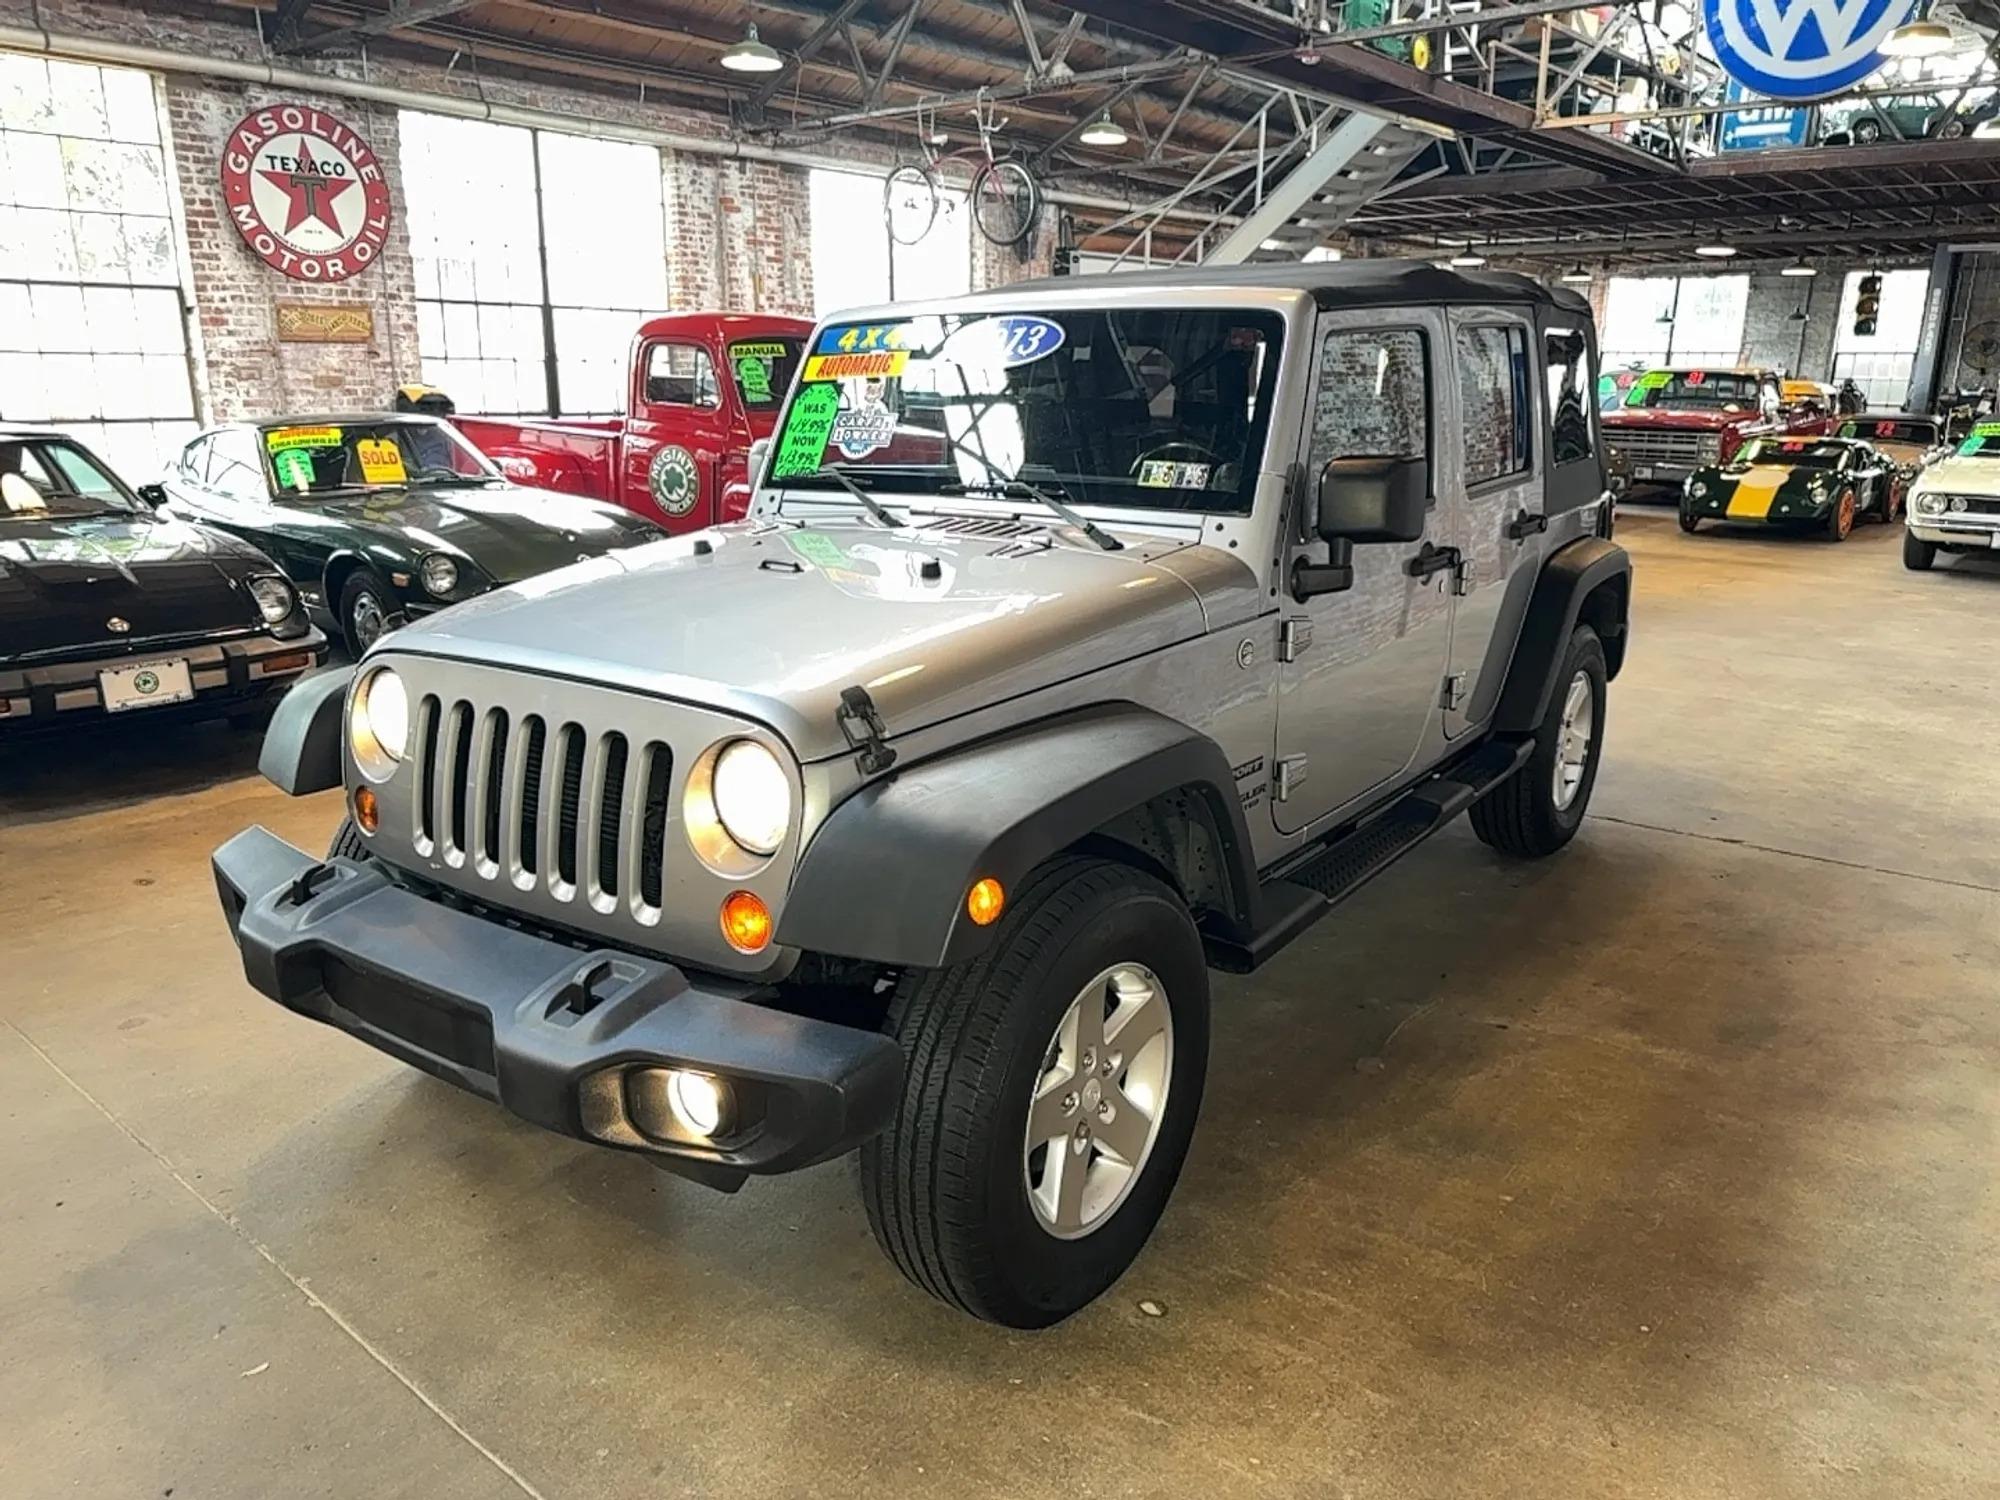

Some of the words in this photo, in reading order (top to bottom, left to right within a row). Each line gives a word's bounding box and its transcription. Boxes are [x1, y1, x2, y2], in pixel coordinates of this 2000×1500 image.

[228, 107, 380, 184] GASOLINE
[265, 154, 346, 177] TEXACO
[234, 203, 347, 278] MOTOR
[353, 214, 387, 263] OIL
[734, 345, 784, 357] MANUAL
[816, 353, 895, 377] AUTOMATIC
[803, 403, 828, 414] WAS
[791, 436, 819, 447] NOW
[362, 450, 399, 466] SOLD
